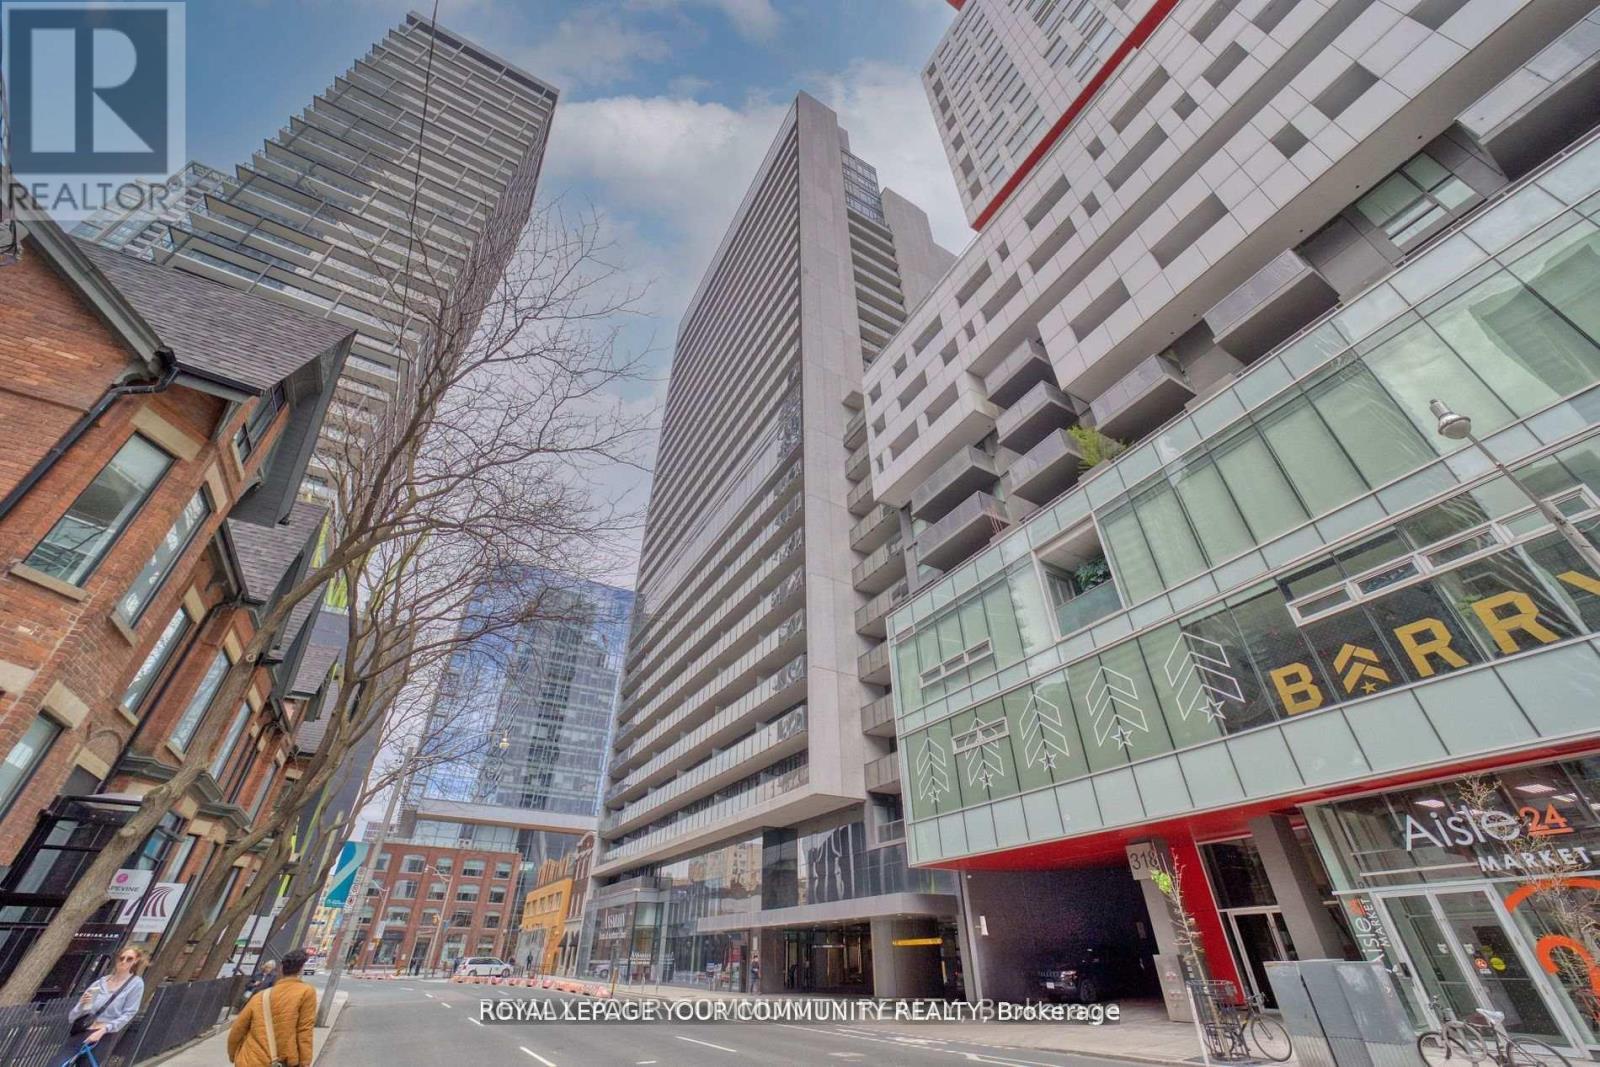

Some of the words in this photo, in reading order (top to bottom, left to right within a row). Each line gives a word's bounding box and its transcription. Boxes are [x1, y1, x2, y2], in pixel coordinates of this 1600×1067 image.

[1129, 850, 1159, 870] 318
[1478, 846, 1592, 873] MARKET
[1360, 897, 1391, 947] MARKET
